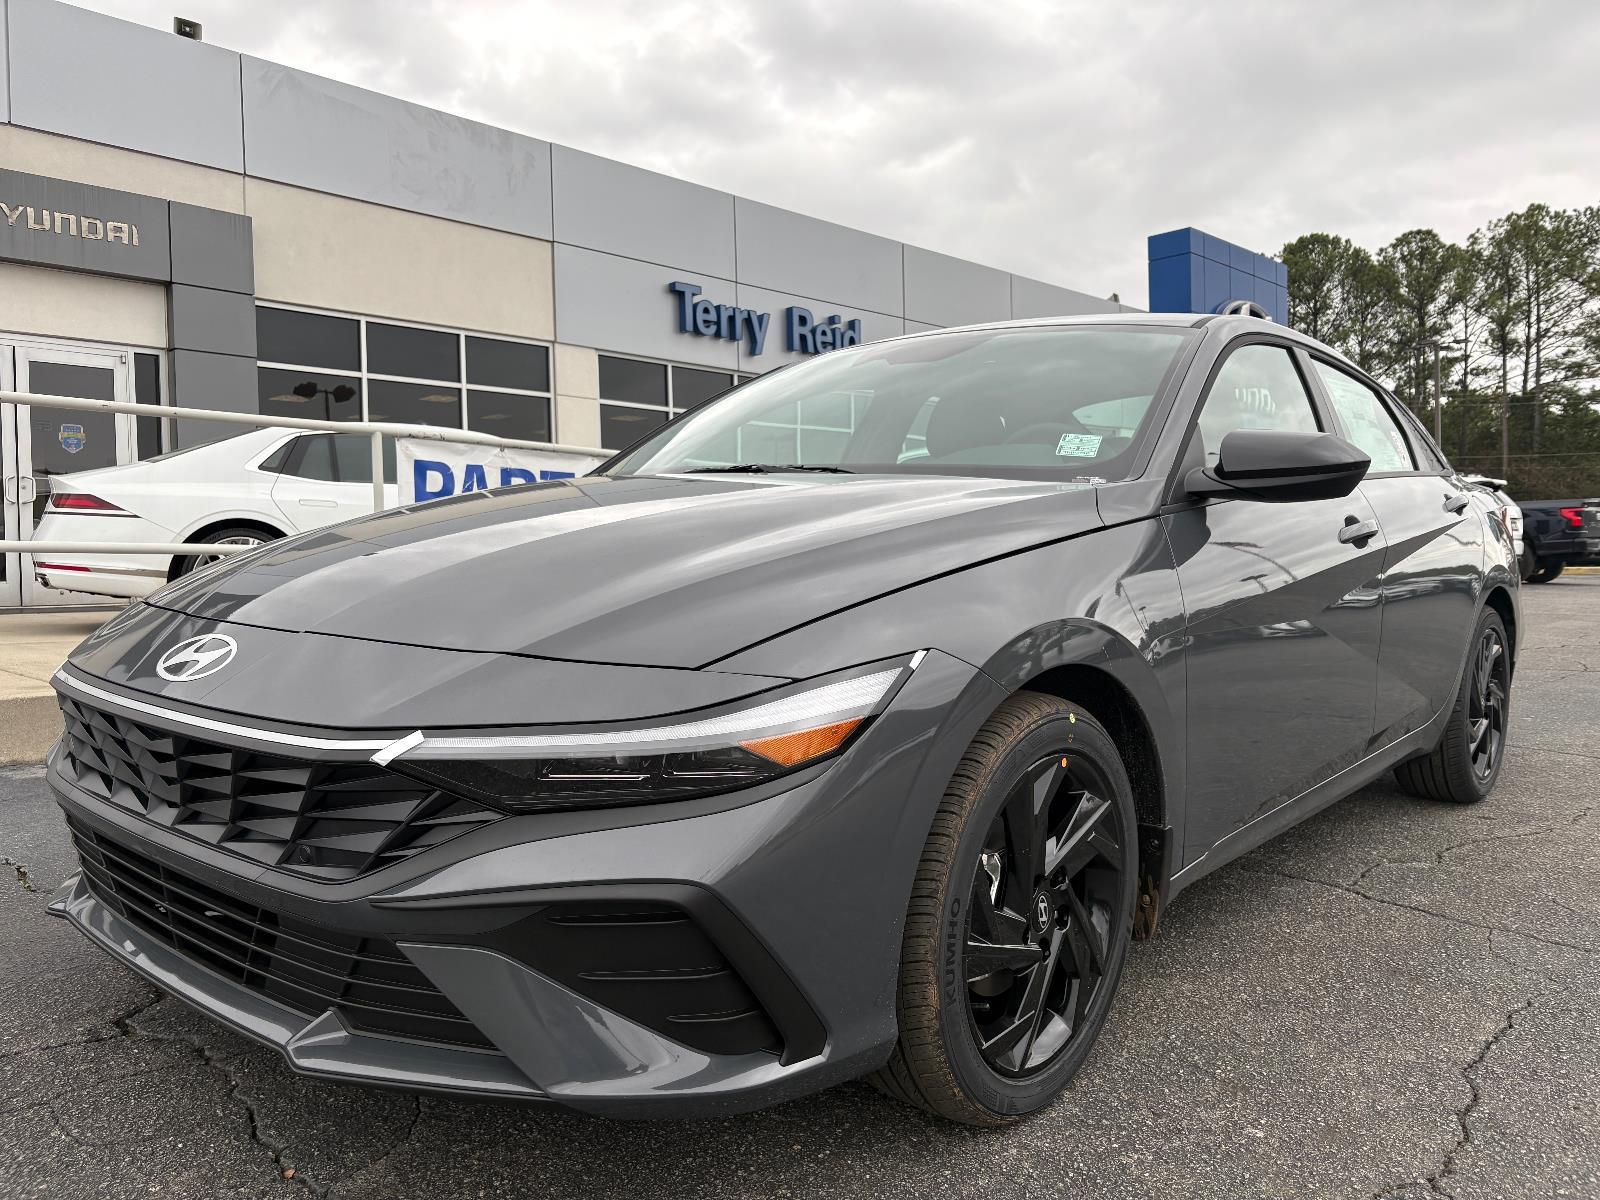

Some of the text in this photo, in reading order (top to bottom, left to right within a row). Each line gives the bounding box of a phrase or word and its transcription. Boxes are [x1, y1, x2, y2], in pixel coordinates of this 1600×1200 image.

[669, 281, 861, 356] Terry Reid
[413, 459, 576, 504] PA
[944, 898, 961, 1008] KUMHO
